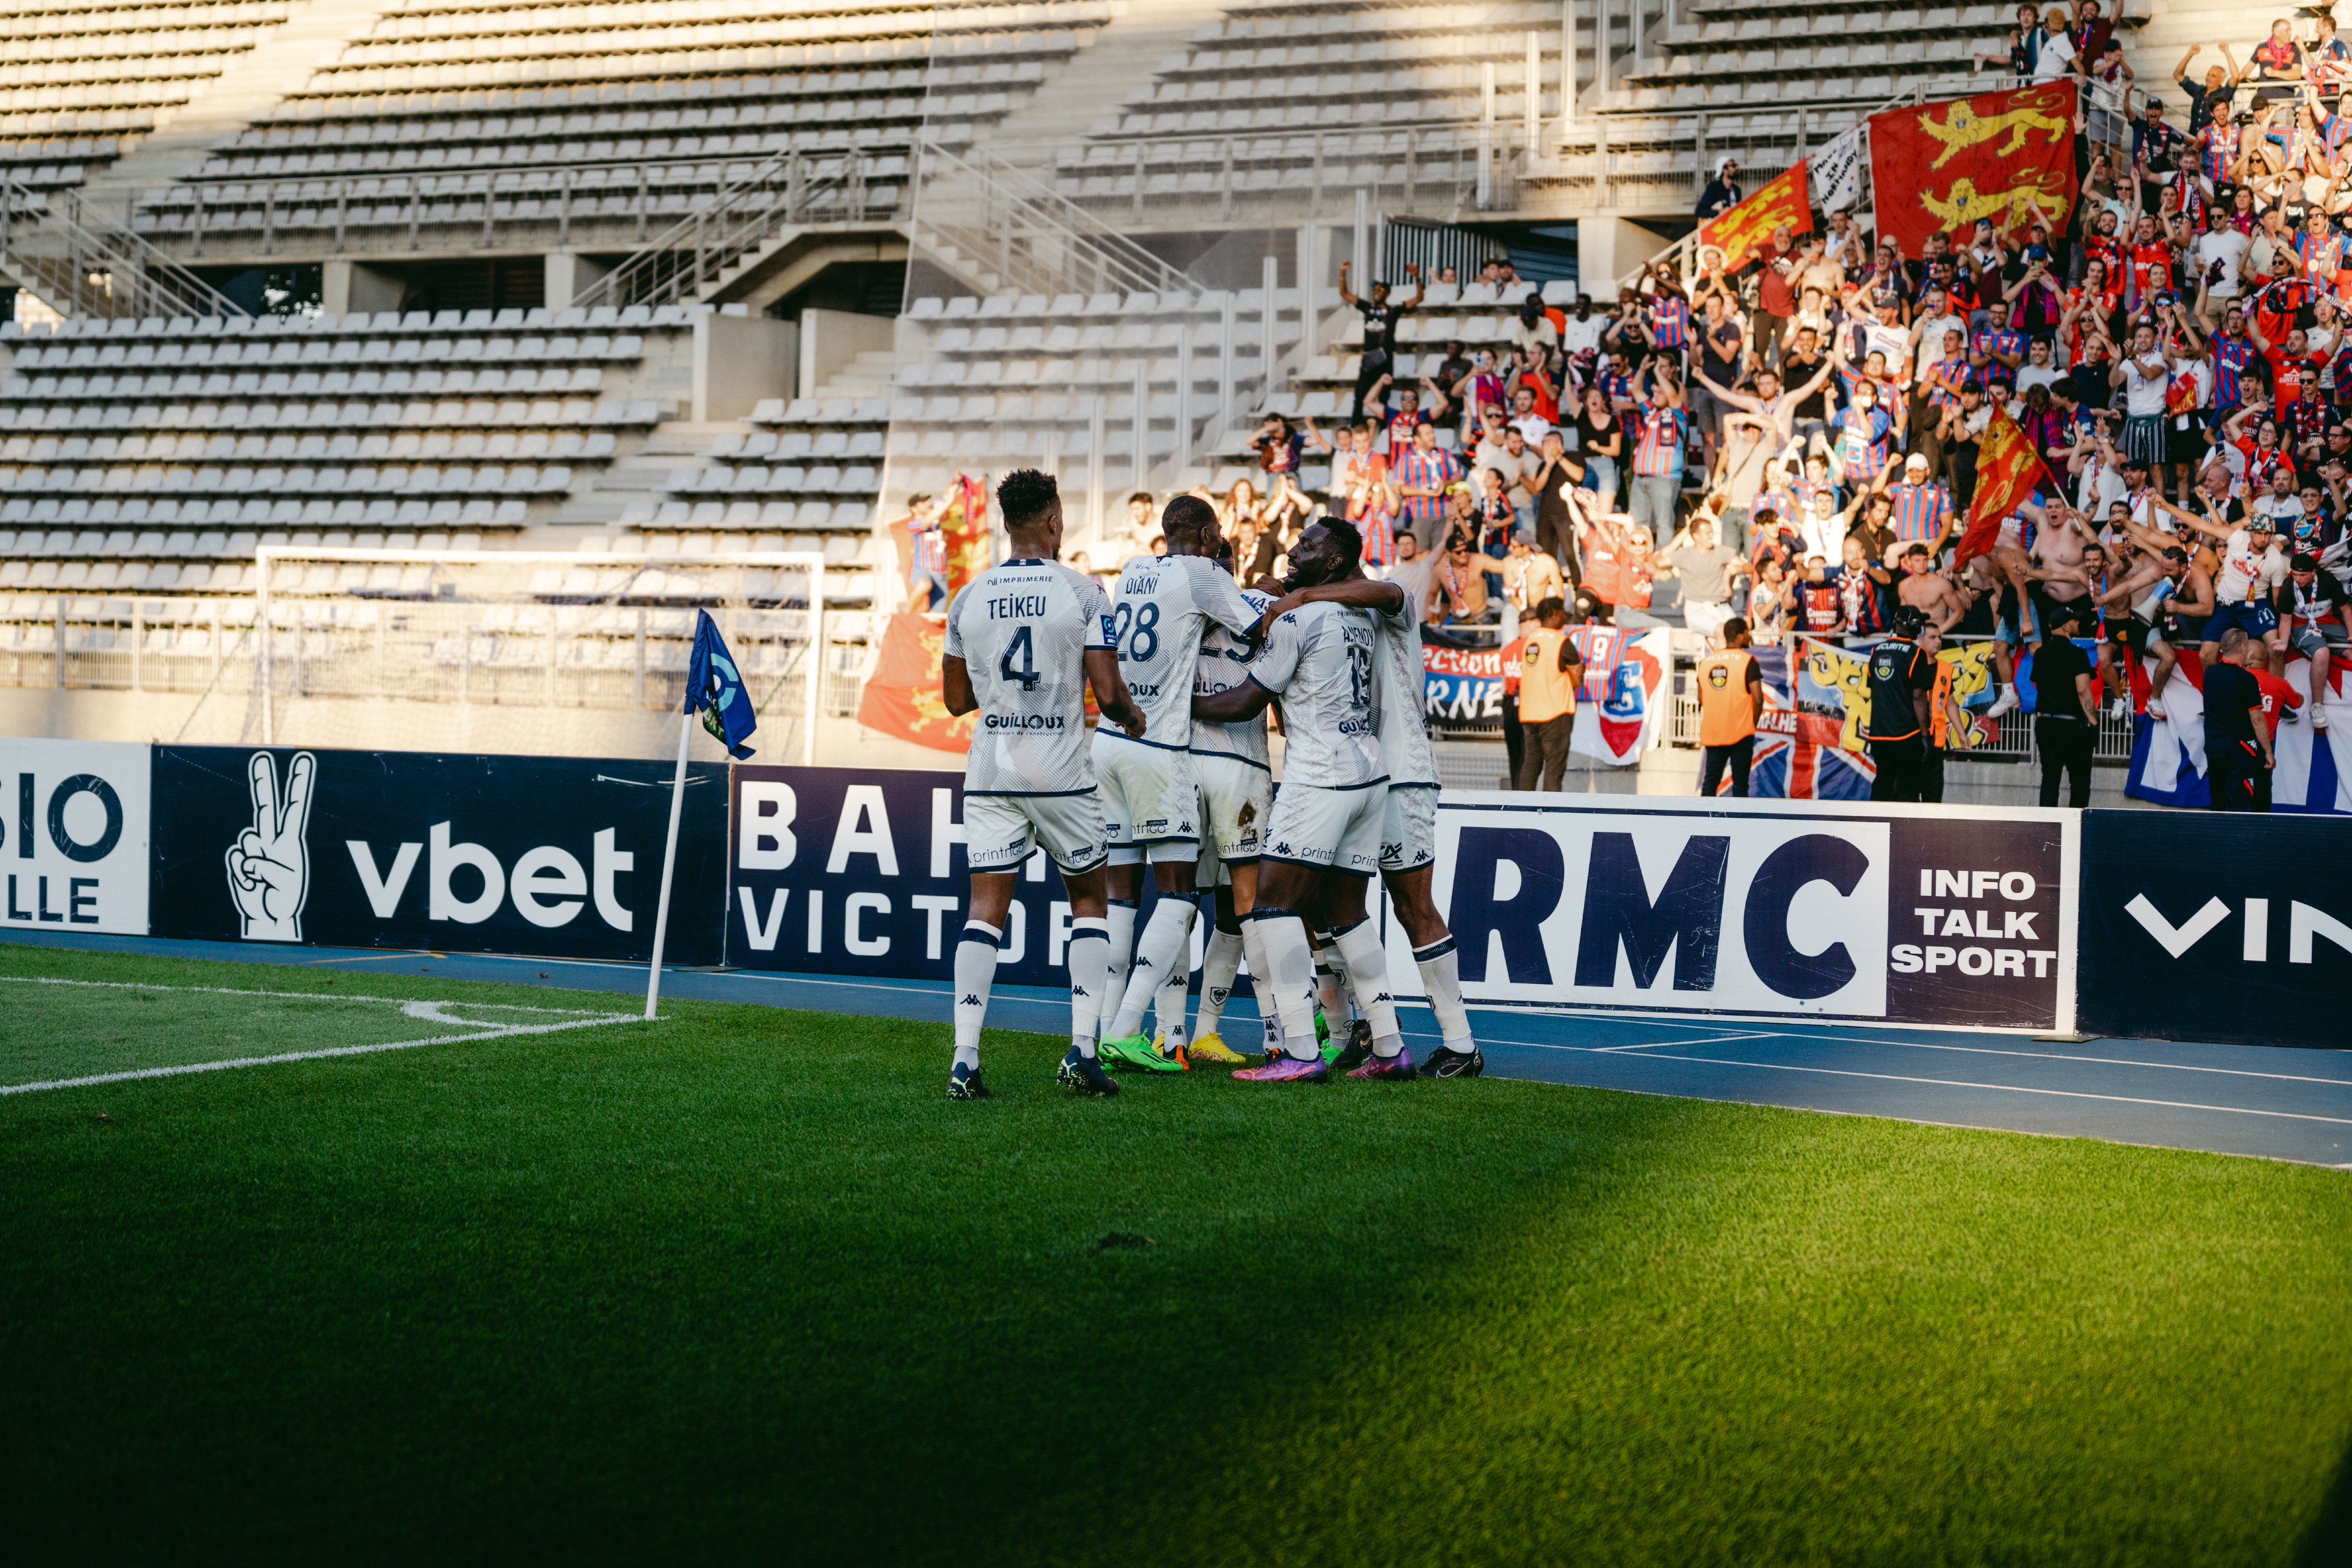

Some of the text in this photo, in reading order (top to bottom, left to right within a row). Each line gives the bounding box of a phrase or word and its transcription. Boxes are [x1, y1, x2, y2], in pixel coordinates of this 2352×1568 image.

[1821, 149, 1857, 204] NORMANDY
[1826, 162, 1838, 180] IN
[1000, 576, 1054, 584] IMPRIMERIE
[1115, 602, 1160, 663] 28
[1593, 636, 1608, 662] 9
[999, 626, 1042, 691] 4
[0, 772, 123, 862] IO
[1049, 849, 1091, 864] rintnGO
[345, 820, 633, 932] vbet
[1920, 869, 2036, 901] INFO
[1448, 826, 1870, 1000] RMC
[1914, 908, 2039, 940] TALK
[1890, 944, 2057, 978] SPORT
